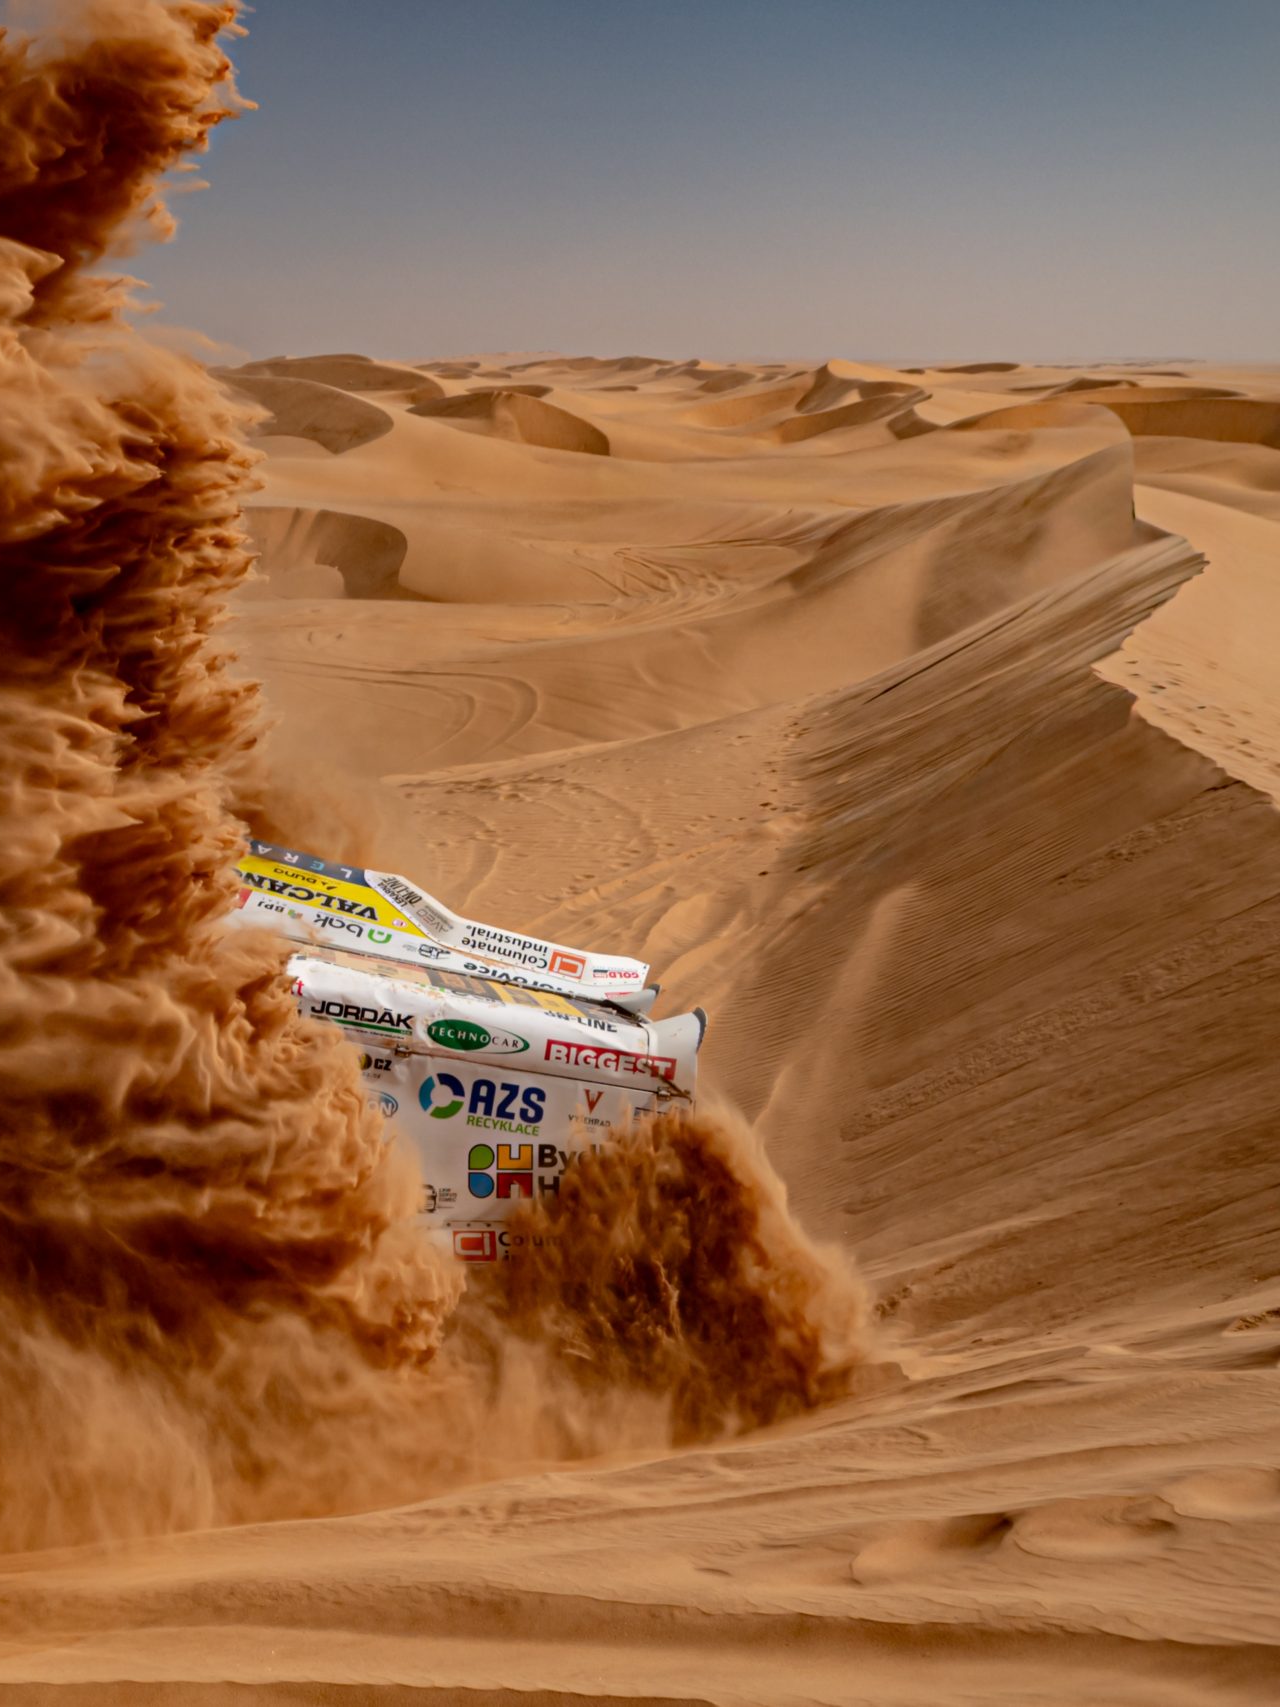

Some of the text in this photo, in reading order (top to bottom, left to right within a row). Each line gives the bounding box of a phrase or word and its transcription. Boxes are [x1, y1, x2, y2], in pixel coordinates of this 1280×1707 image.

[312, 913, 364, 937] bak
[460, 936, 548, 970] Columnate
[608, 971, 639, 979] GOLD
[430, 1025, 519, 1049] TECHNOCAR
[551, 1044, 672, 1077] BIGGEST
[468, 1078, 546, 1124] AZS
[466, 1115, 540, 1136] RECYKLACE
